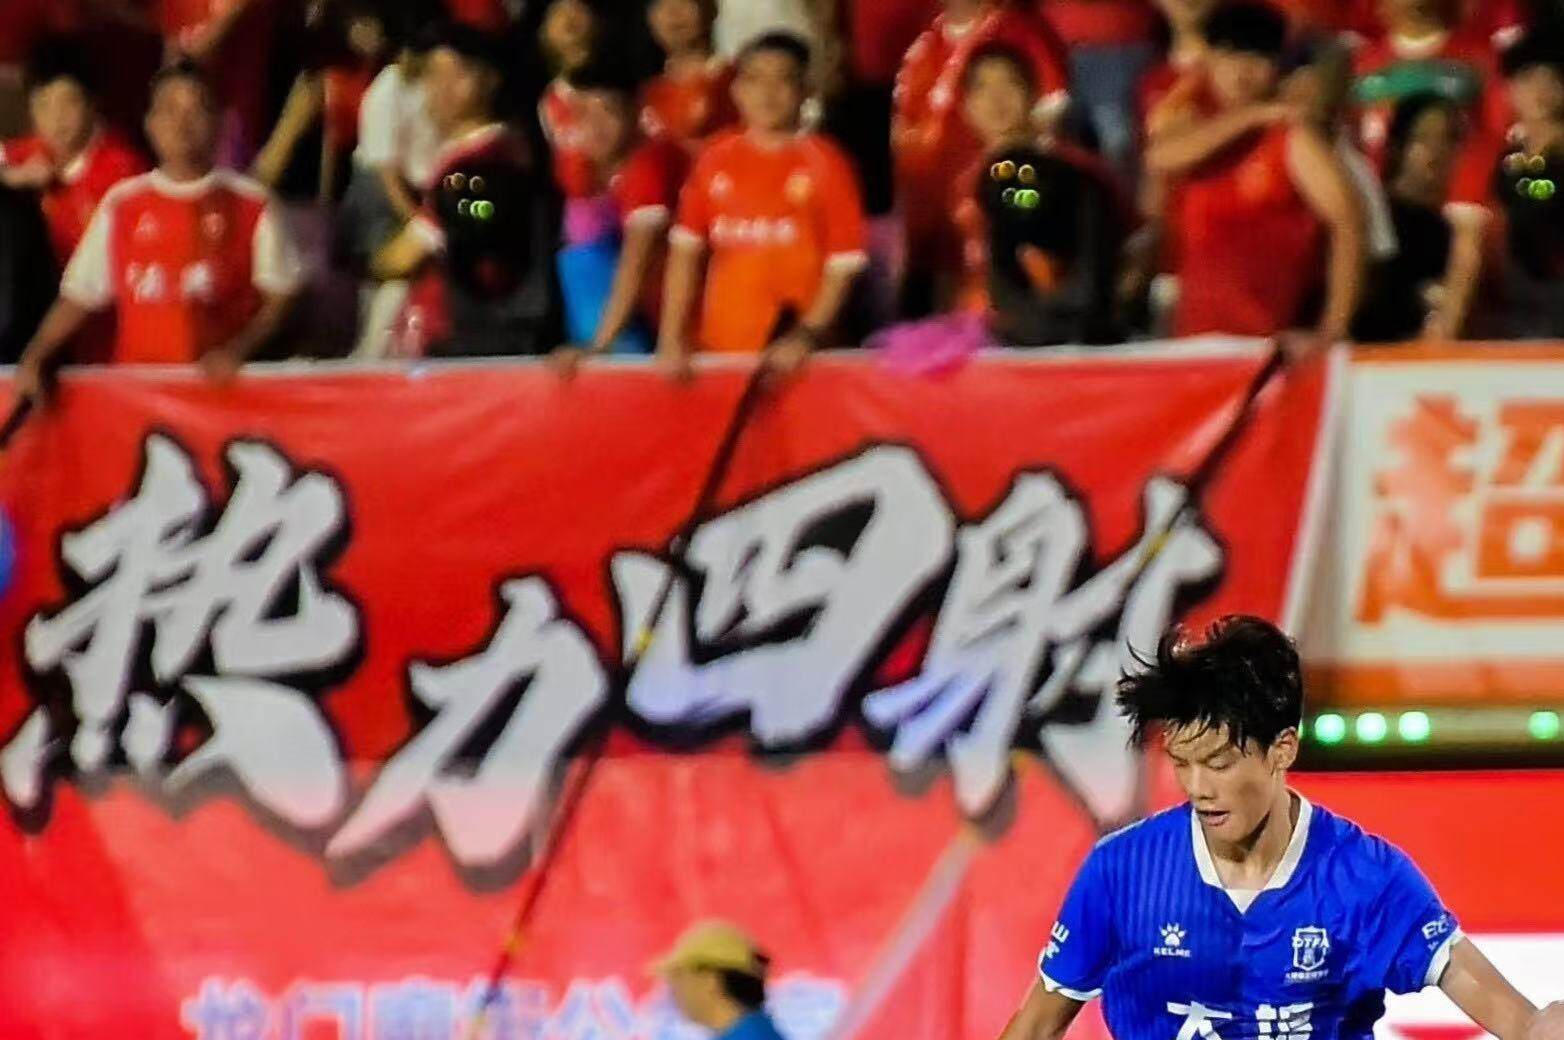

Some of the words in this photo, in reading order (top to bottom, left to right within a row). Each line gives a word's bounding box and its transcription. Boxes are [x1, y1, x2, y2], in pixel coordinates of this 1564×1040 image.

[2, 430, 1226, 885] 热力四射
[1153, 946, 1191, 958] KELME
